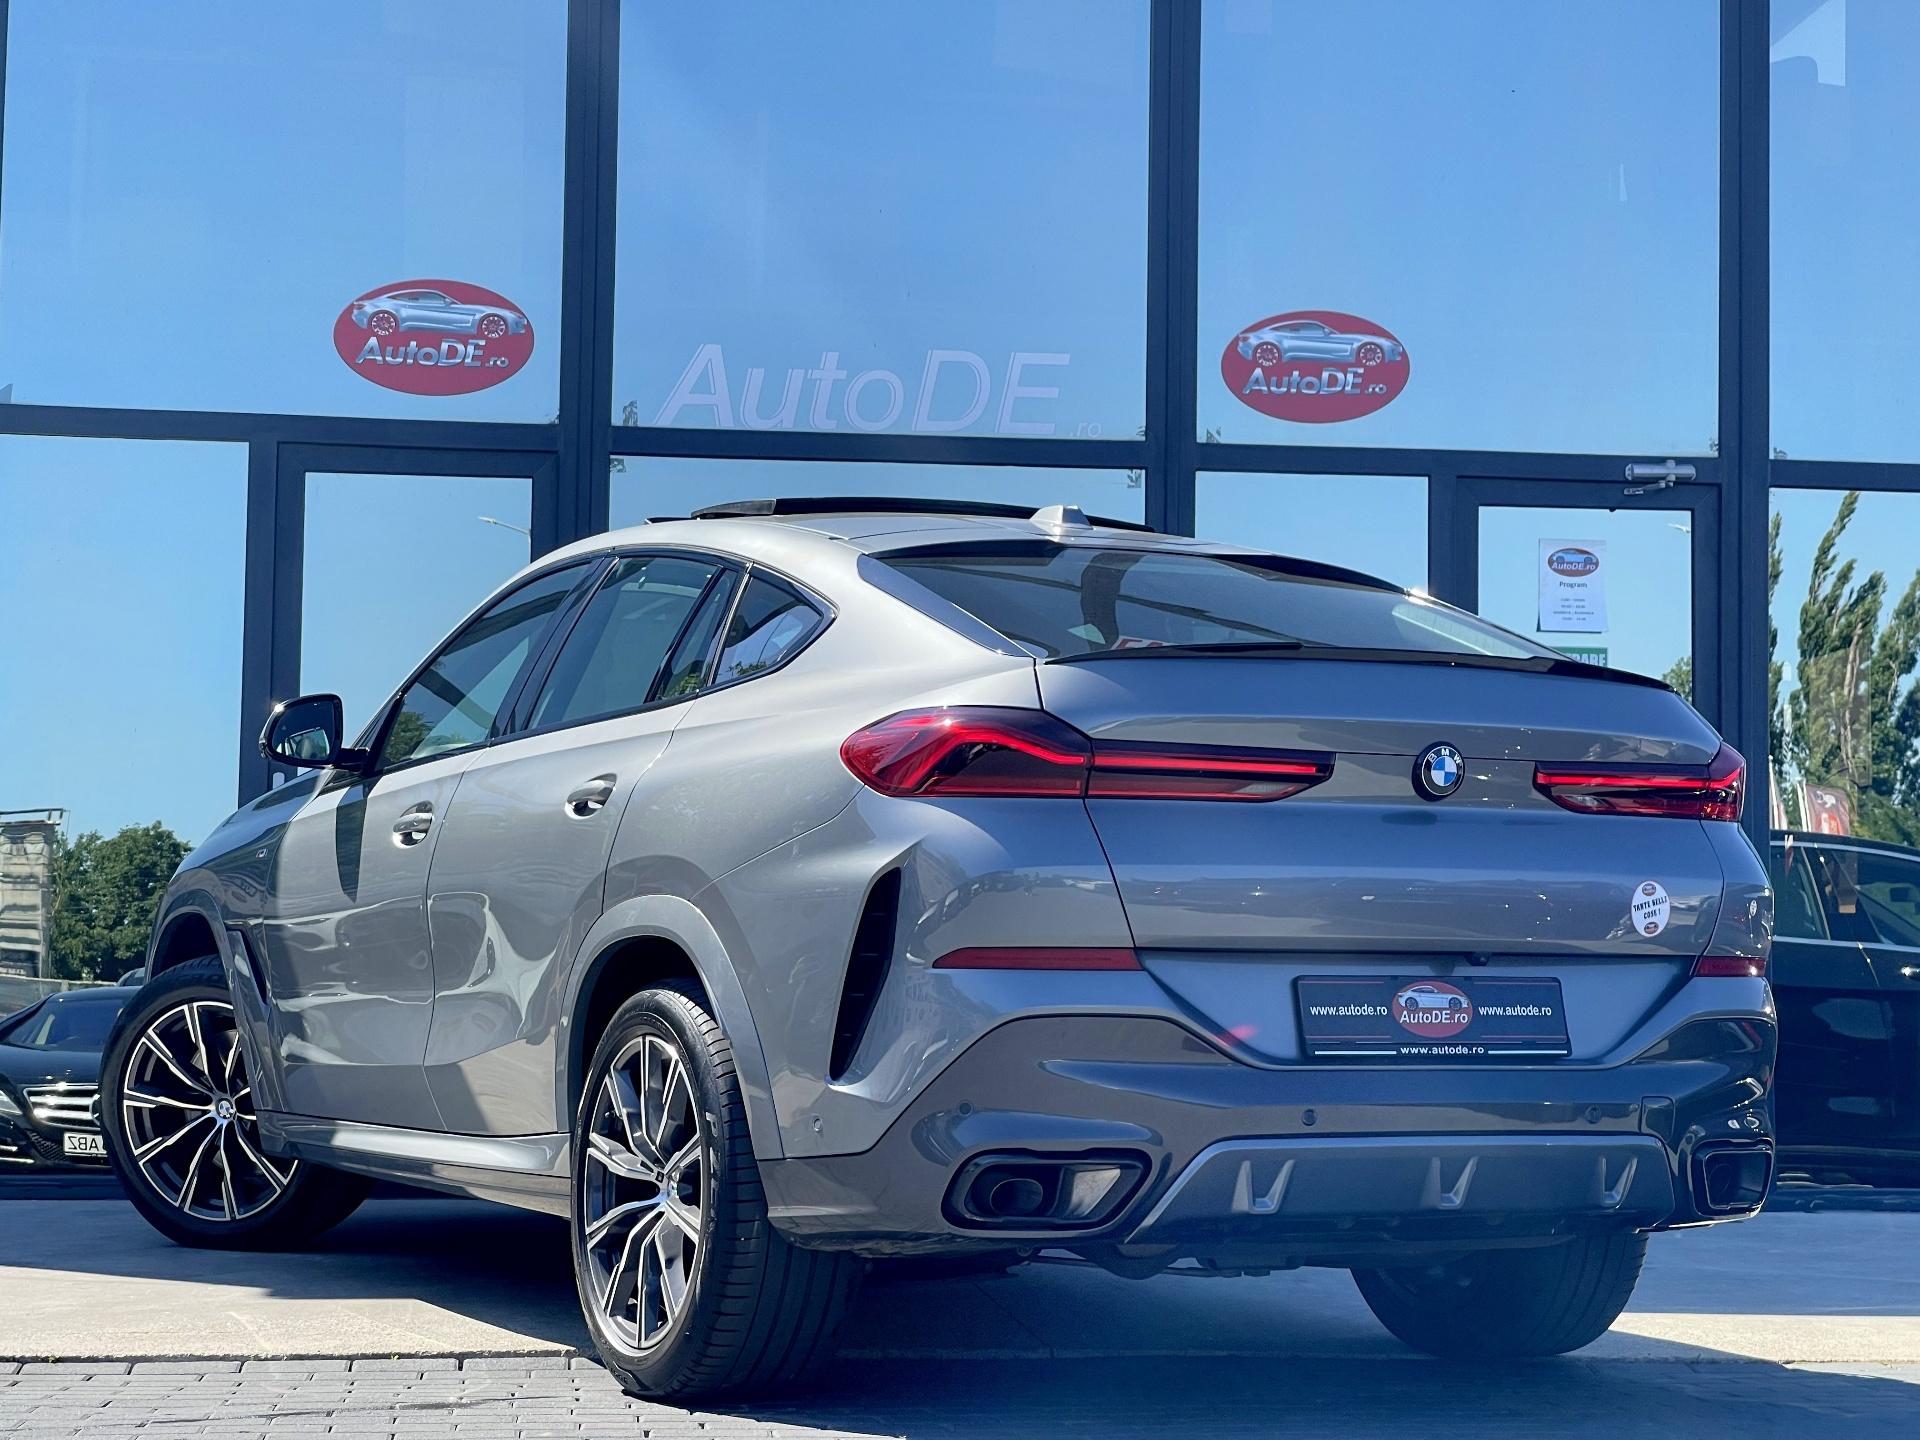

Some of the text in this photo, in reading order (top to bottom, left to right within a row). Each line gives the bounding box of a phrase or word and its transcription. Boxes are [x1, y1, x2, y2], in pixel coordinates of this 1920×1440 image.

[1559, 581, 1588, 589] Program
[1428, 748, 1463, 765] BMW
[1310, 1003, 1388, 1016] www.autode.ro
[1478, 1004, 1552, 1016] www.autode.ro
[1400, 1010, 1469, 1024] AutoDE.ro
[1400, 1045, 1485, 1055] www.autode.ro
